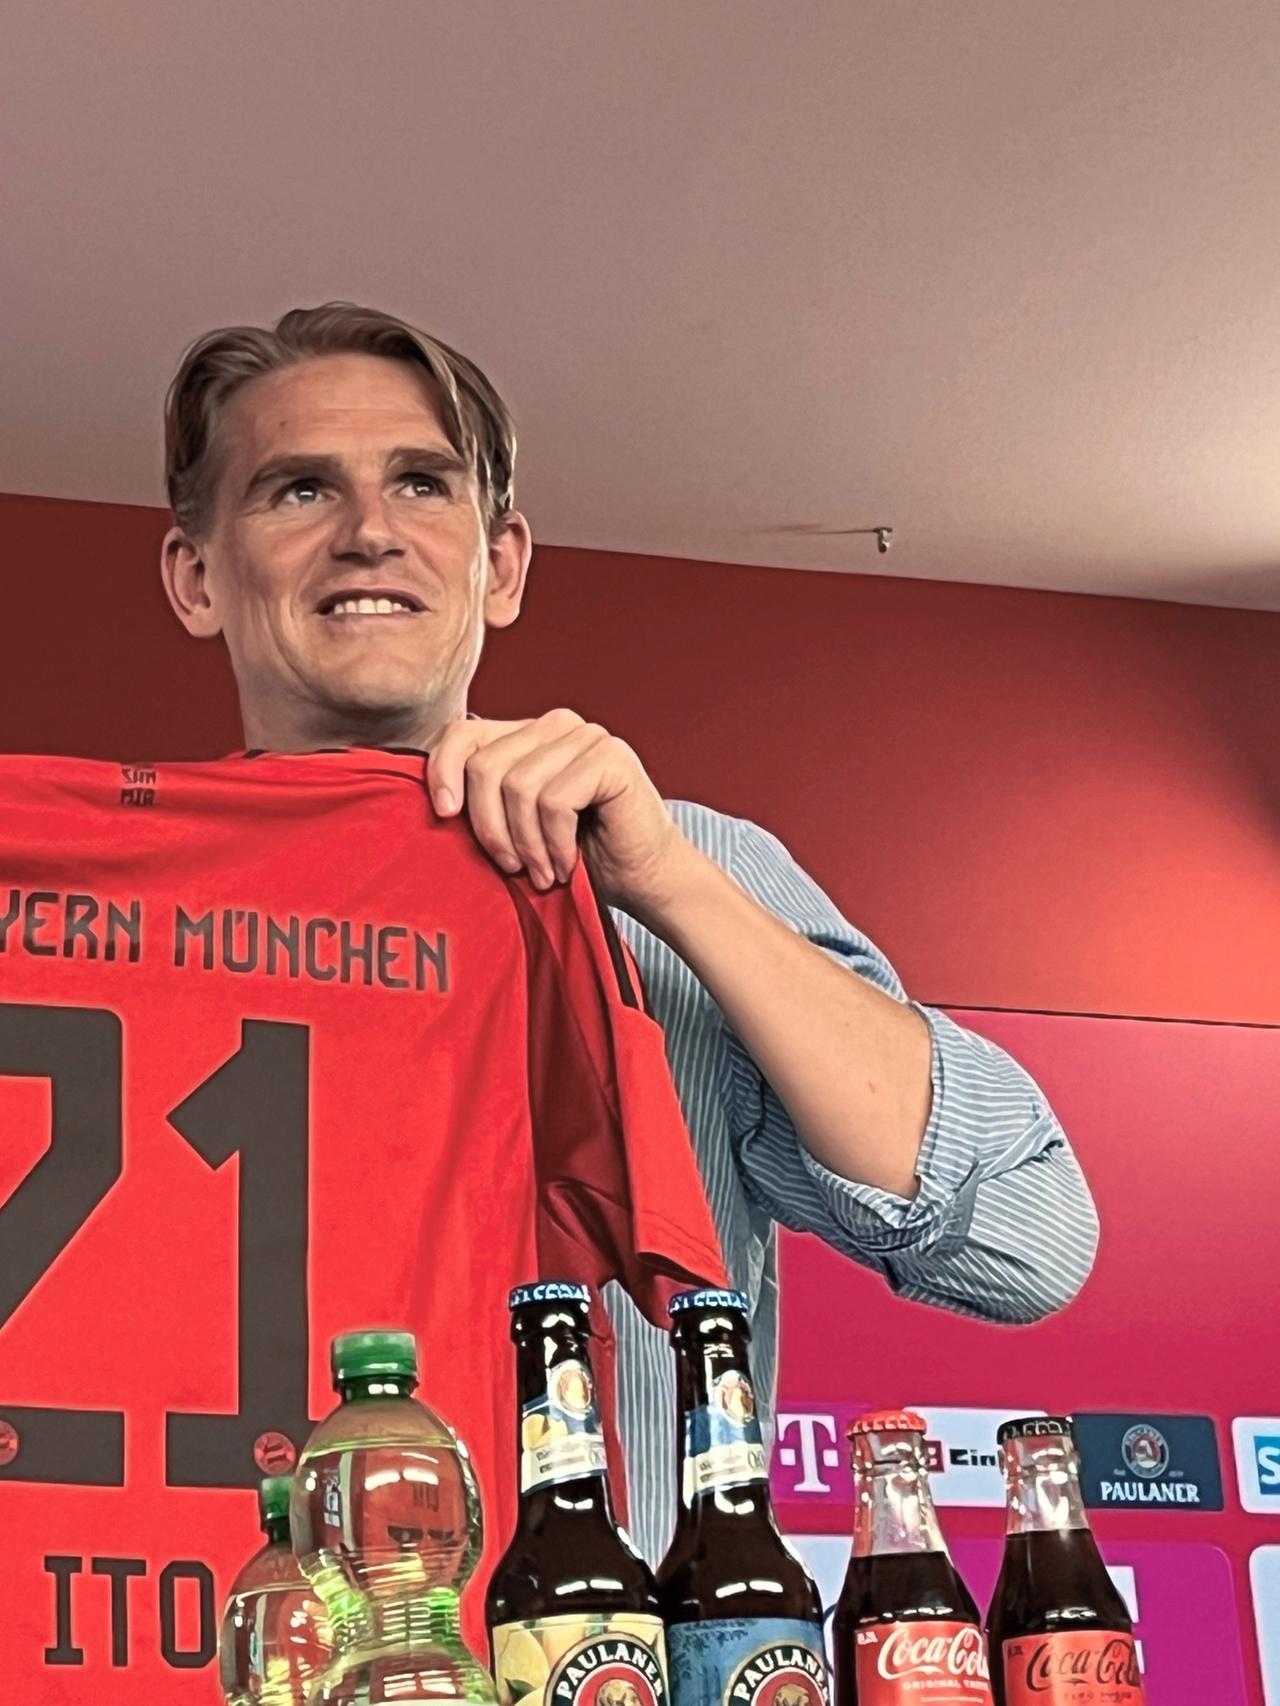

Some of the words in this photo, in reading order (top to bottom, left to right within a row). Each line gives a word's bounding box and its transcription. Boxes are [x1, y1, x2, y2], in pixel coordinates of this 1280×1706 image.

[174, 906, 448, 993] MÜNCHEN
[1101, 1481, 1200, 1503] PAULANER
[44, 1555, 218, 1669] ITO
